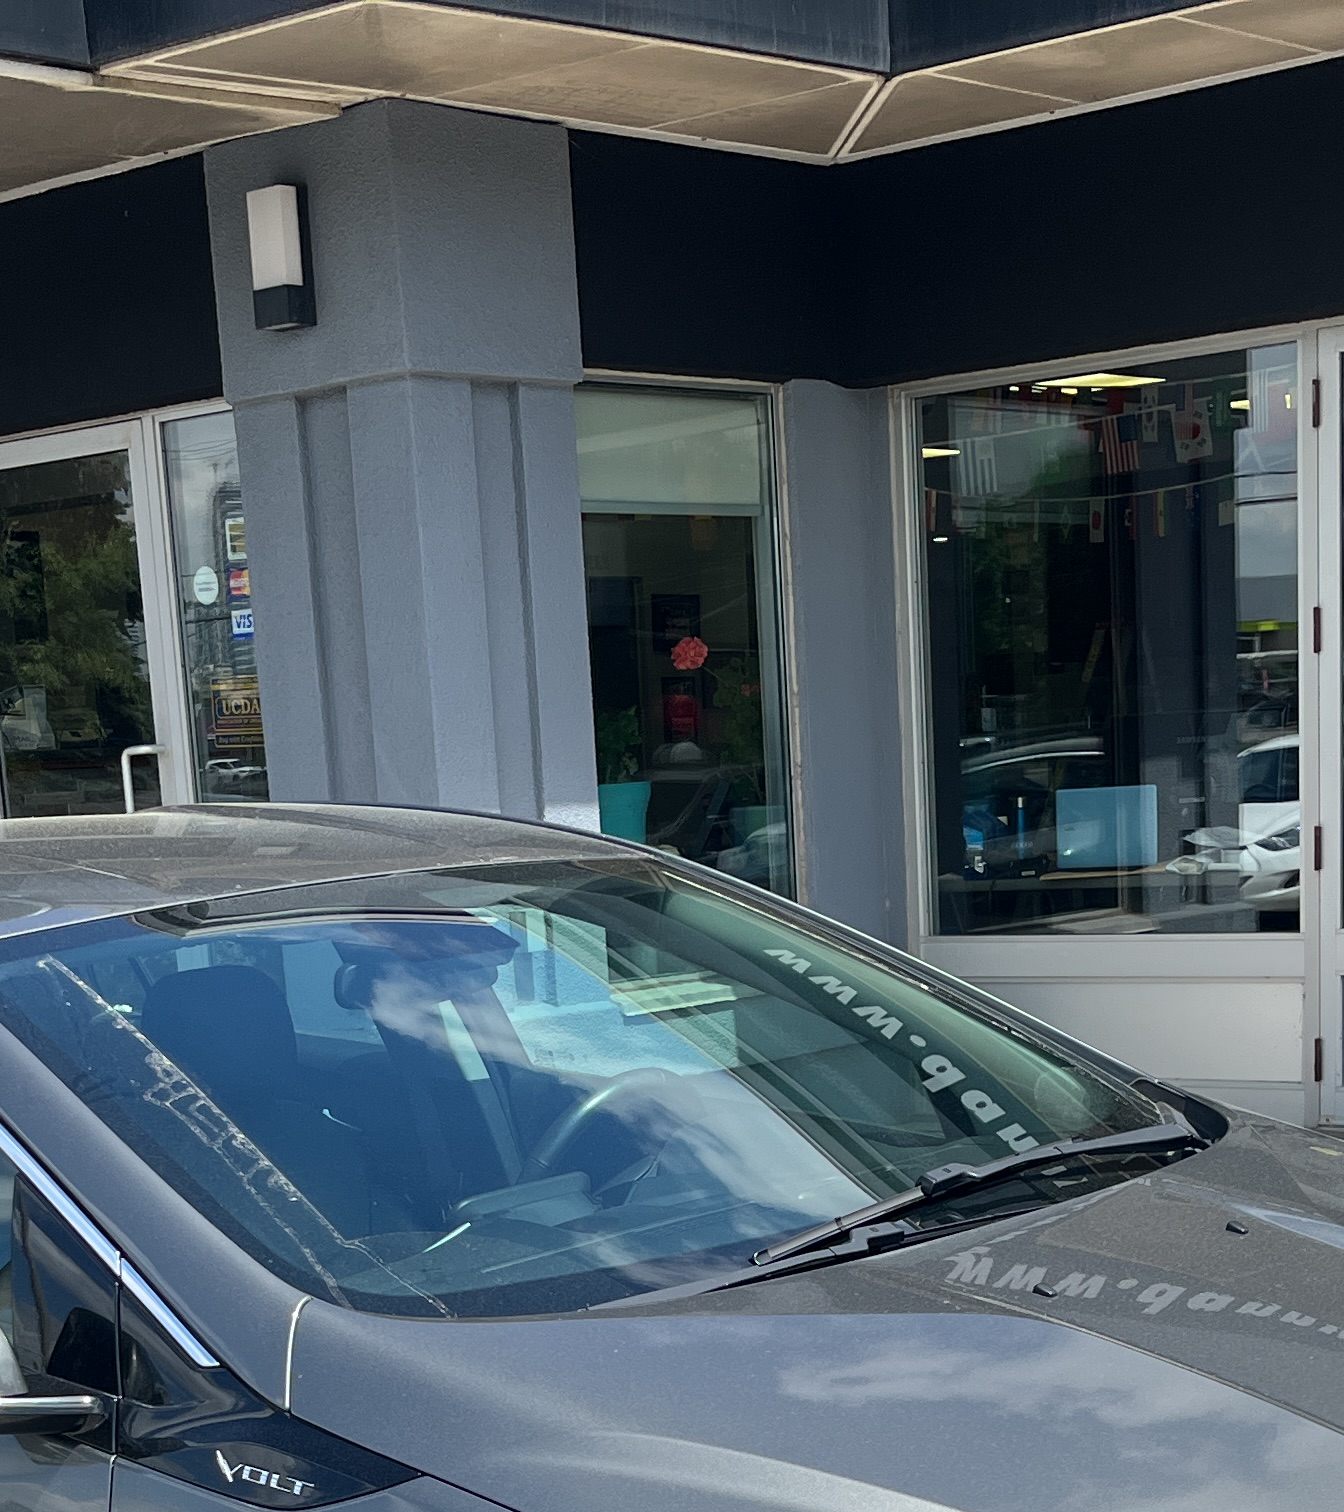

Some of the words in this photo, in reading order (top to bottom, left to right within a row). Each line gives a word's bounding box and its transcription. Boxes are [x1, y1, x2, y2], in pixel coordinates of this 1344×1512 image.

[236, 614, 253, 629] VIS
[222, 698, 260, 715] UCDA
[215, 1449, 315, 1496] VOLT
